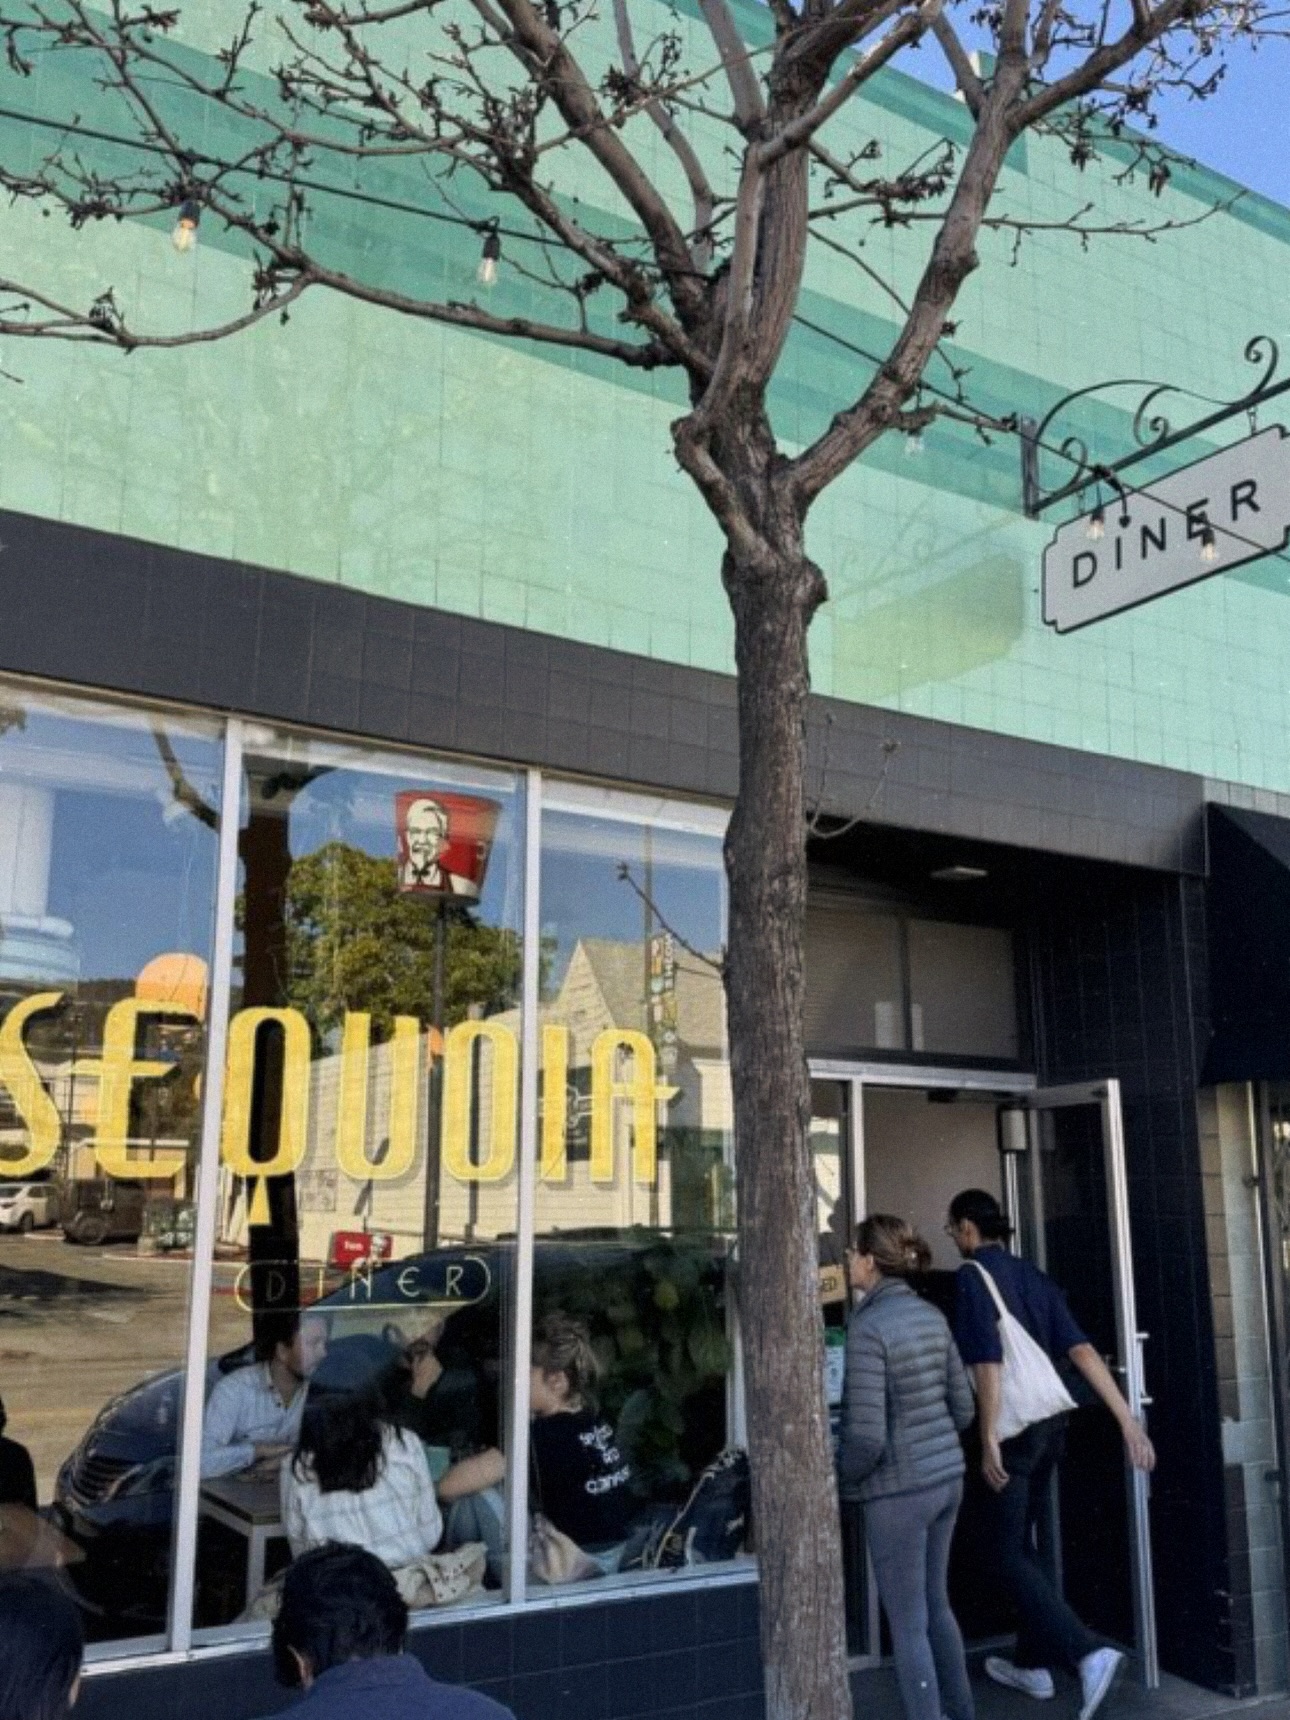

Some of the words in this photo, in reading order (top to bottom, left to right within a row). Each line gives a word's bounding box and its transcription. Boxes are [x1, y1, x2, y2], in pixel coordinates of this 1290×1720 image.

[1073, 479, 1261, 588] DINER
[0, 992, 679, 1225] SEQUOIA
[266, 1265, 463, 1302] DINER
